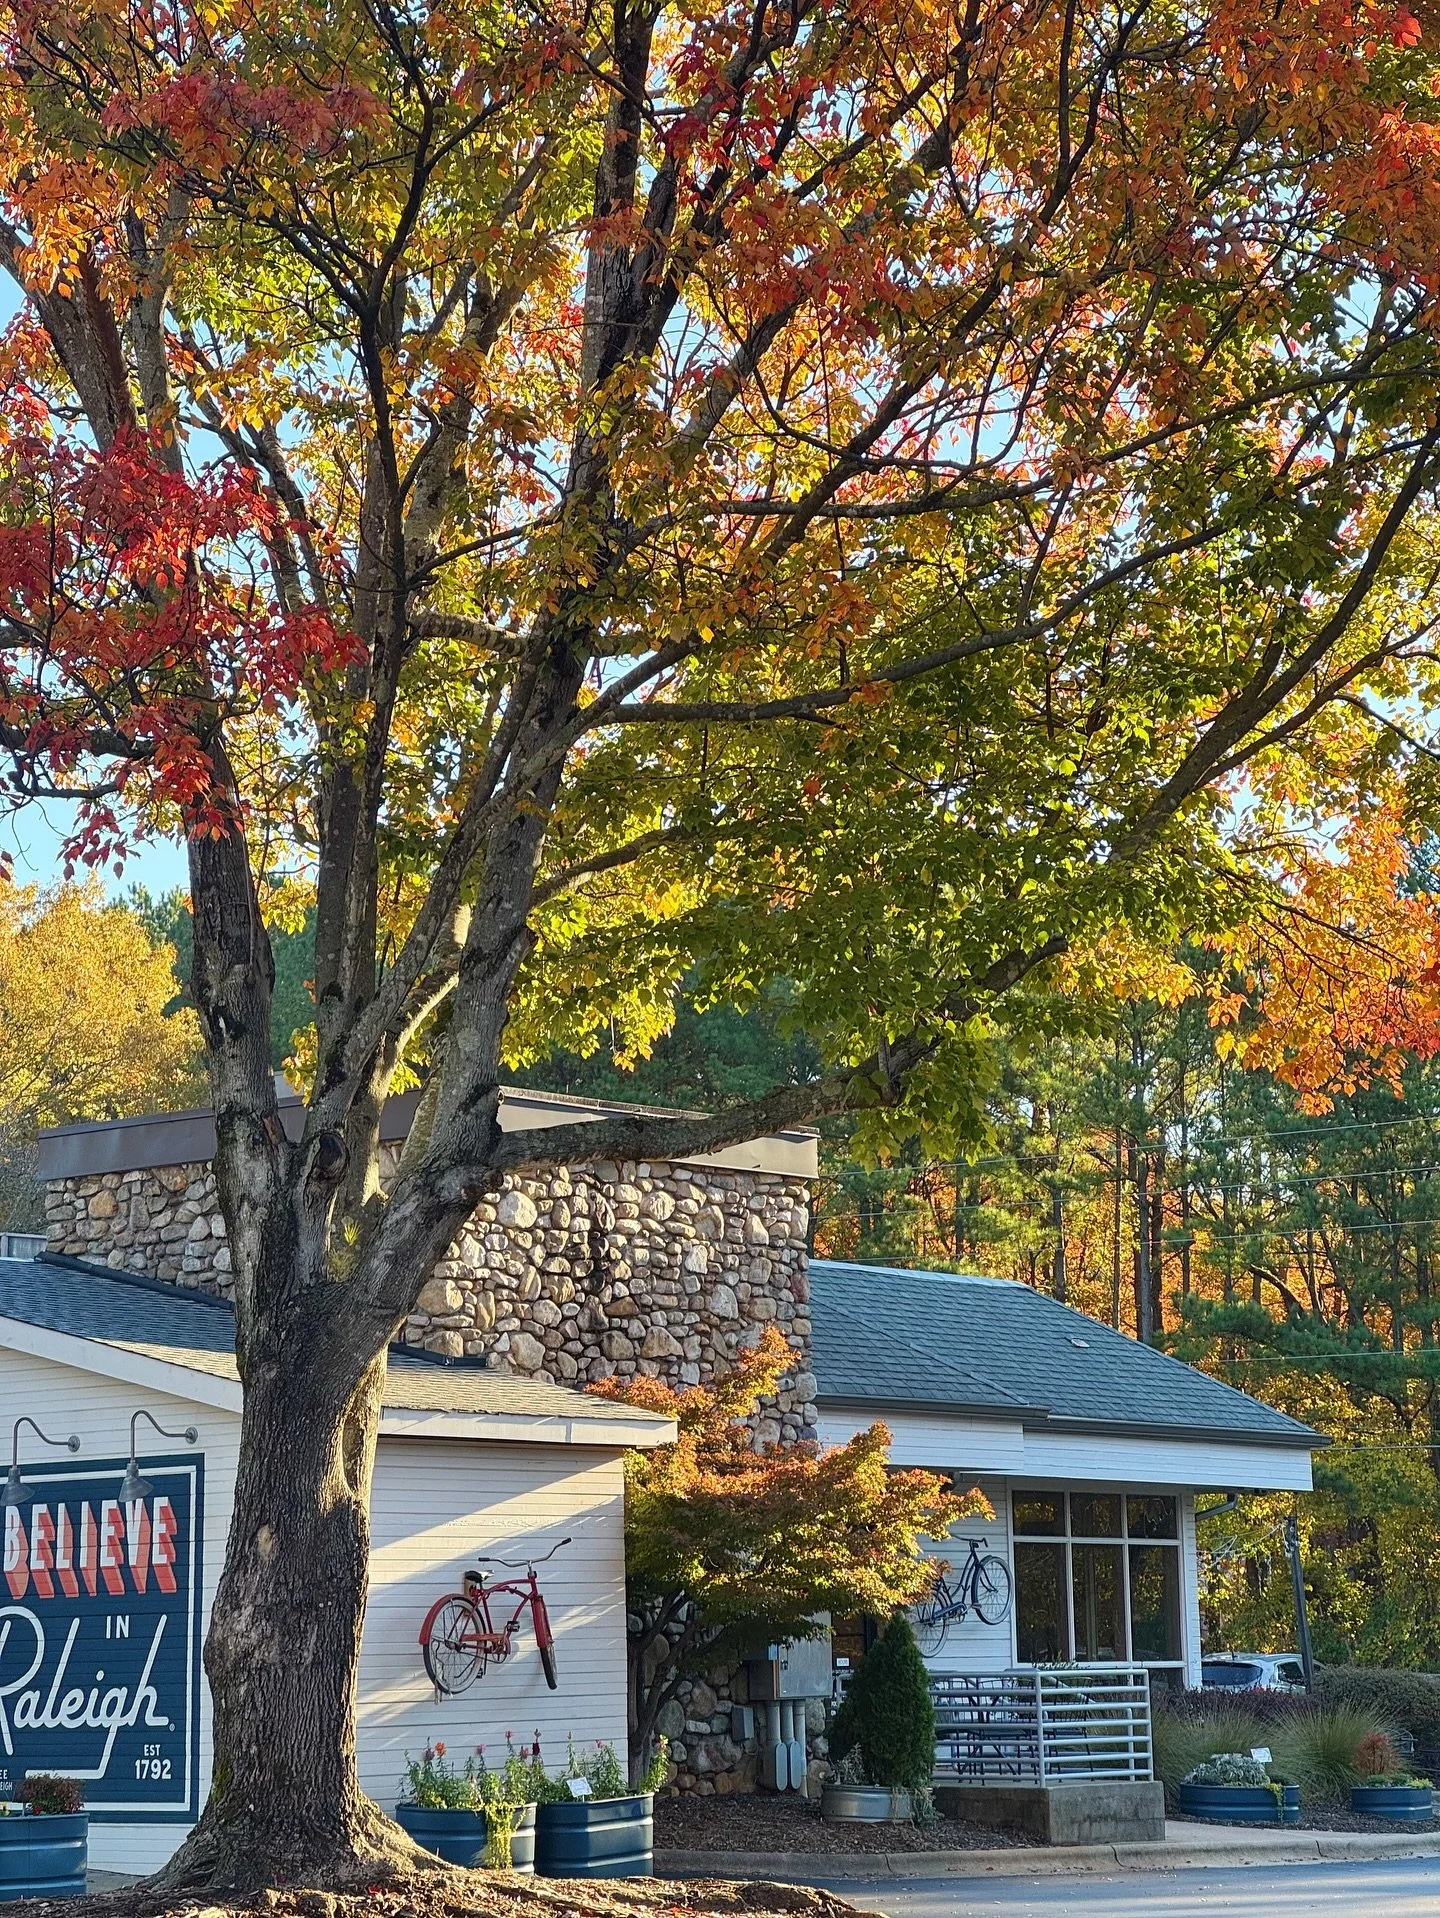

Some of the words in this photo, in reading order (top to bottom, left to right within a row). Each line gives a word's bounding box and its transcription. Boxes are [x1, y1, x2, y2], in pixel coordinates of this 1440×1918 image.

[3, 1496, 178, 1600] BELIEVE
[106, 1615, 130, 1639] IN
[143, 1744, 161, 1757] EST
[135, 1758, 172, 1780] 1792
